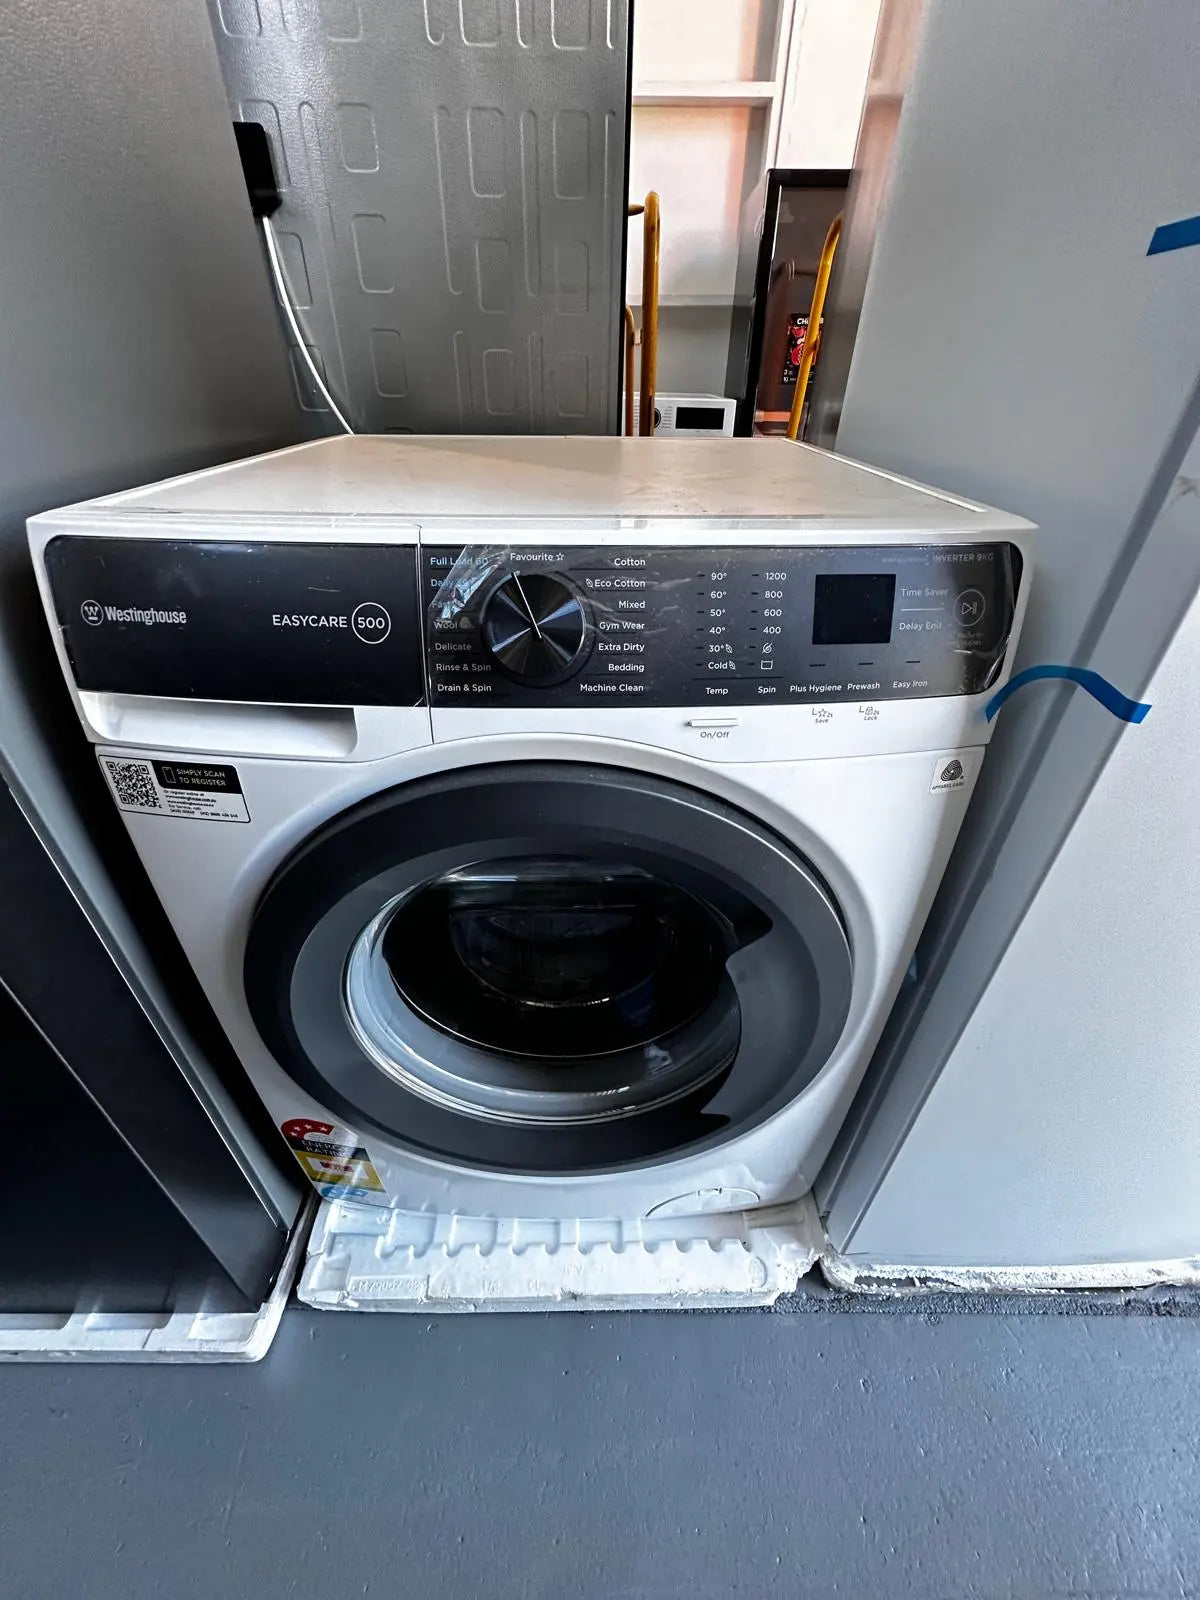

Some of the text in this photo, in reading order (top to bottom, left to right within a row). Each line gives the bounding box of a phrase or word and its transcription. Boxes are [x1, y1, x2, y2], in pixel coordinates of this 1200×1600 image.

[430, 557, 447, 565] Full
[510, 552, 553, 561] Favourite
[932, 553, 974, 563] INVERTER
[976, 552, 994, 562] 9KG
[614, 557, 646, 566] Cotton
[710, 572, 727, 580] 90°
[765, 572, 787, 580] 1200
[594, 579, 646, 587] Eco Cotton
[710, 590, 727, 599] 60°
[764, 590, 783, 599] 800
[901, 587, 948, 597] Time Saver
[618, 600, 646, 608] Mixed
[104, 606, 187, 626] Westinghouse
[709, 608, 726, 617] 50°
[763, 608, 782, 617] 600
[272, 614, 385, 629] EASYCARE 500
[433, 621, 458, 629] Wool
[599, 621, 645, 631] Gym Wear
[899, 621, 942, 631] Delay End
[709, 626, 726, 634] 40°
[763, 626, 782, 634] 400
[434, 642, 472, 651] Delicate
[598, 642, 645, 652] Extra Dirty
[436, 663, 492, 672] Rinse & Spin
[608, 663, 645, 672] Bedding
[707, 661, 728, 670] Cold
[437, 684, 492, 693] Drain & Spin
[580, 683, 644, 691] Machine Clean
[789, 684, 842, 694] Plus Hygiene
[847, 682, 881, 690] Prewash
[892, 680, 928, 689] Easy Iron
[705, 687, 729, 696] Temp
[757, 686, 776, 695] Spin
[700, 730, 730, 739] On/Off
[176, 768, 202, 776] SIMPLY
[190, 778, 226, 786] REGISTER
